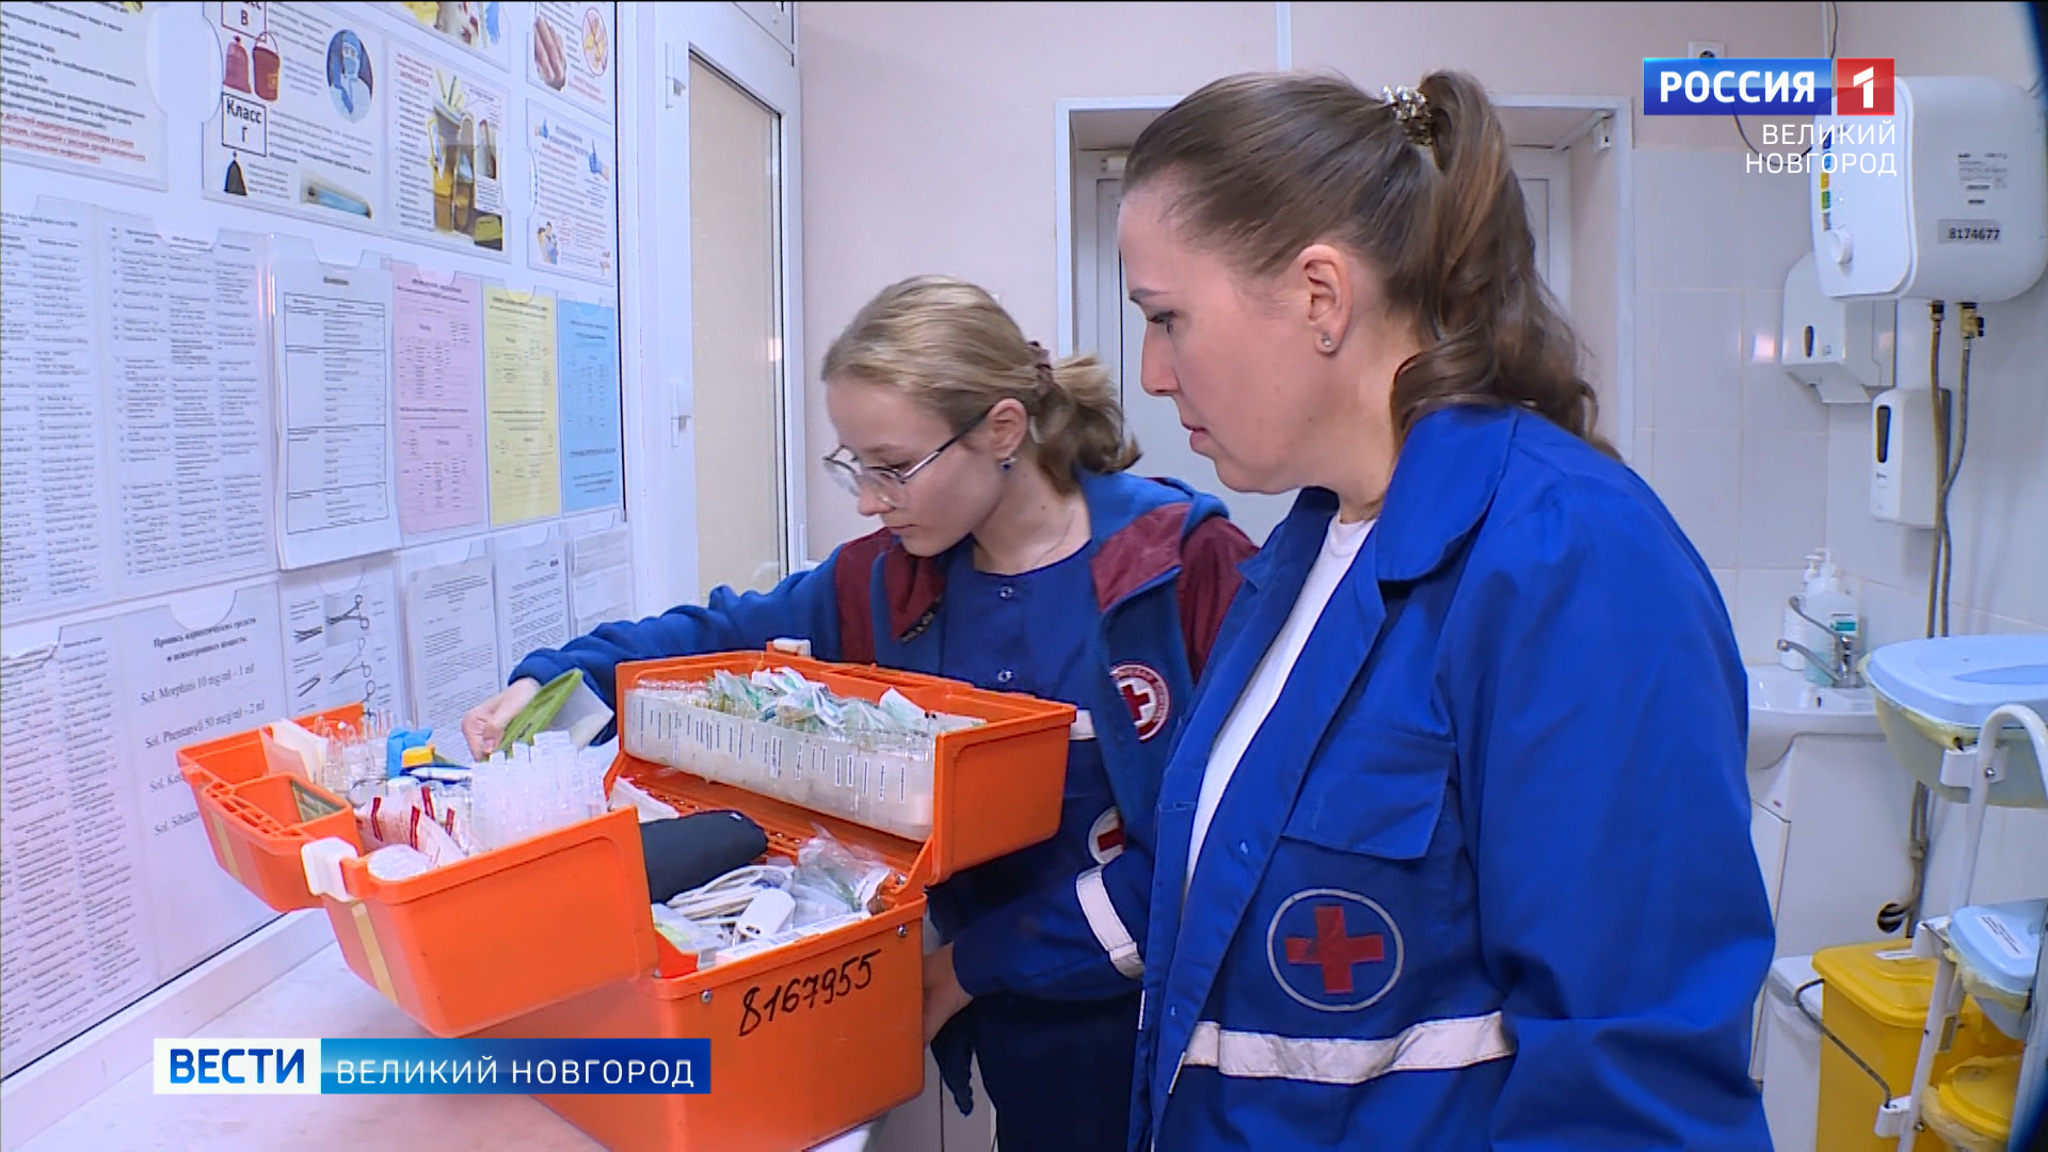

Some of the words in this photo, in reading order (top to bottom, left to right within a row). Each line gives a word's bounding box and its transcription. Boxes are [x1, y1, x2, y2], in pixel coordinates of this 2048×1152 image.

[226, 98, 263, 124] Класс
[1948, 227, 2001, 240] 8174677
[738, 948, 882, 1037] 8167955
